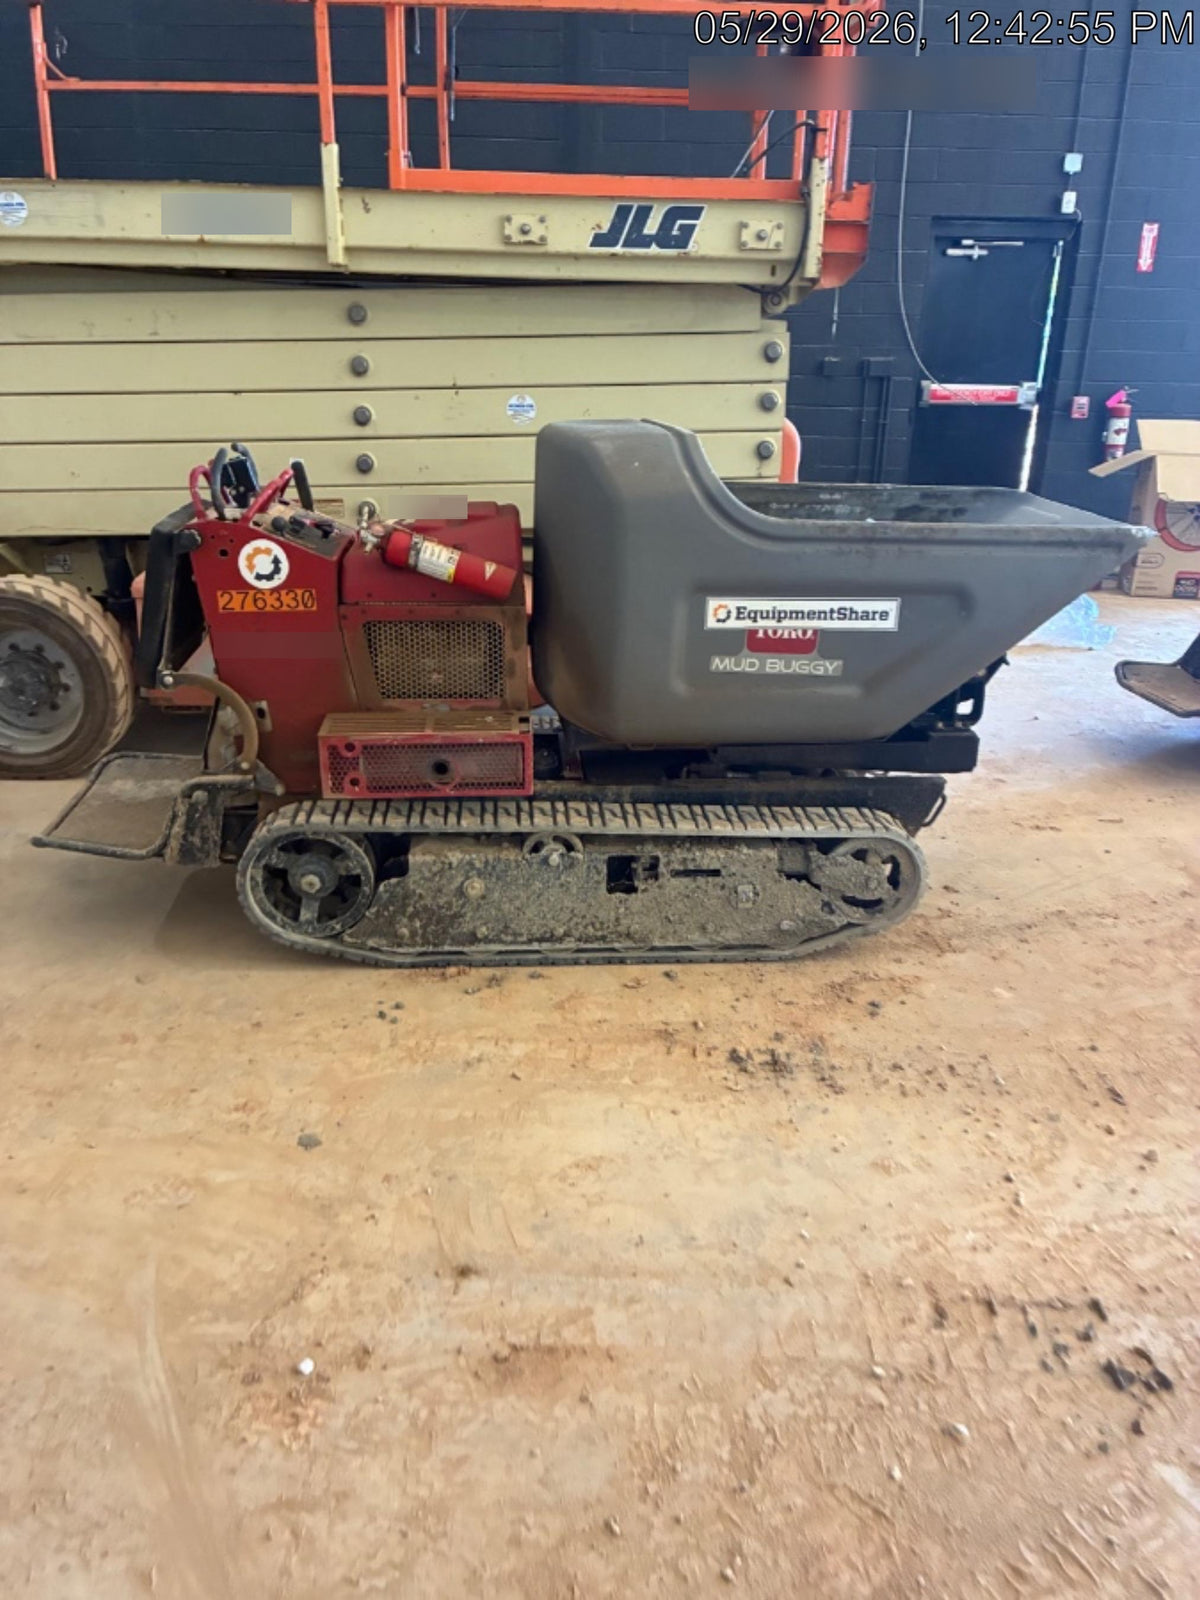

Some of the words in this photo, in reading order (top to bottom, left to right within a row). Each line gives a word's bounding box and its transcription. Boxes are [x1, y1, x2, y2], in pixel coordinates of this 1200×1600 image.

[589, 204, 706, 250] JLG
[220, 590, 316, 611] 276330
[735, 605, 890, 623] EquipmentShare
[711, 656, 760, 672] MUD
[765, 658, 838, 675] BUGGY
